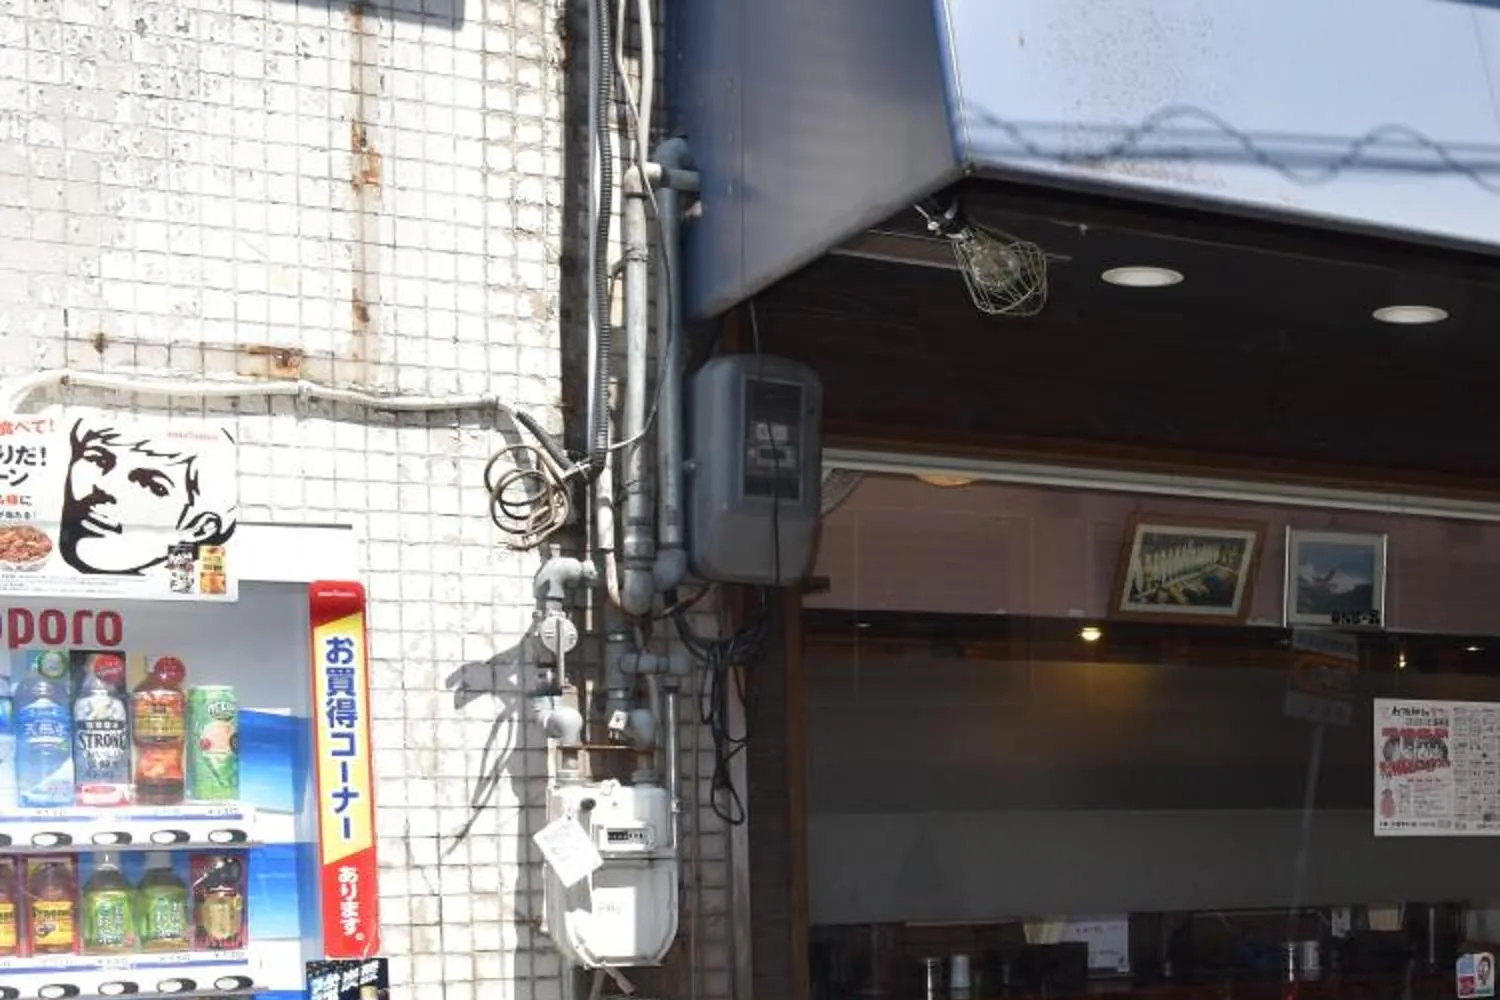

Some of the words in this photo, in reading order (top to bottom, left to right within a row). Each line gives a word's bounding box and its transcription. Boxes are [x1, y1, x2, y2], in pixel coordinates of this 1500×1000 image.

[0, 607, 122, 649] poro
[325, 636, 359, 840] お買得コーナー
[337, 865, 366, 941] あります。
